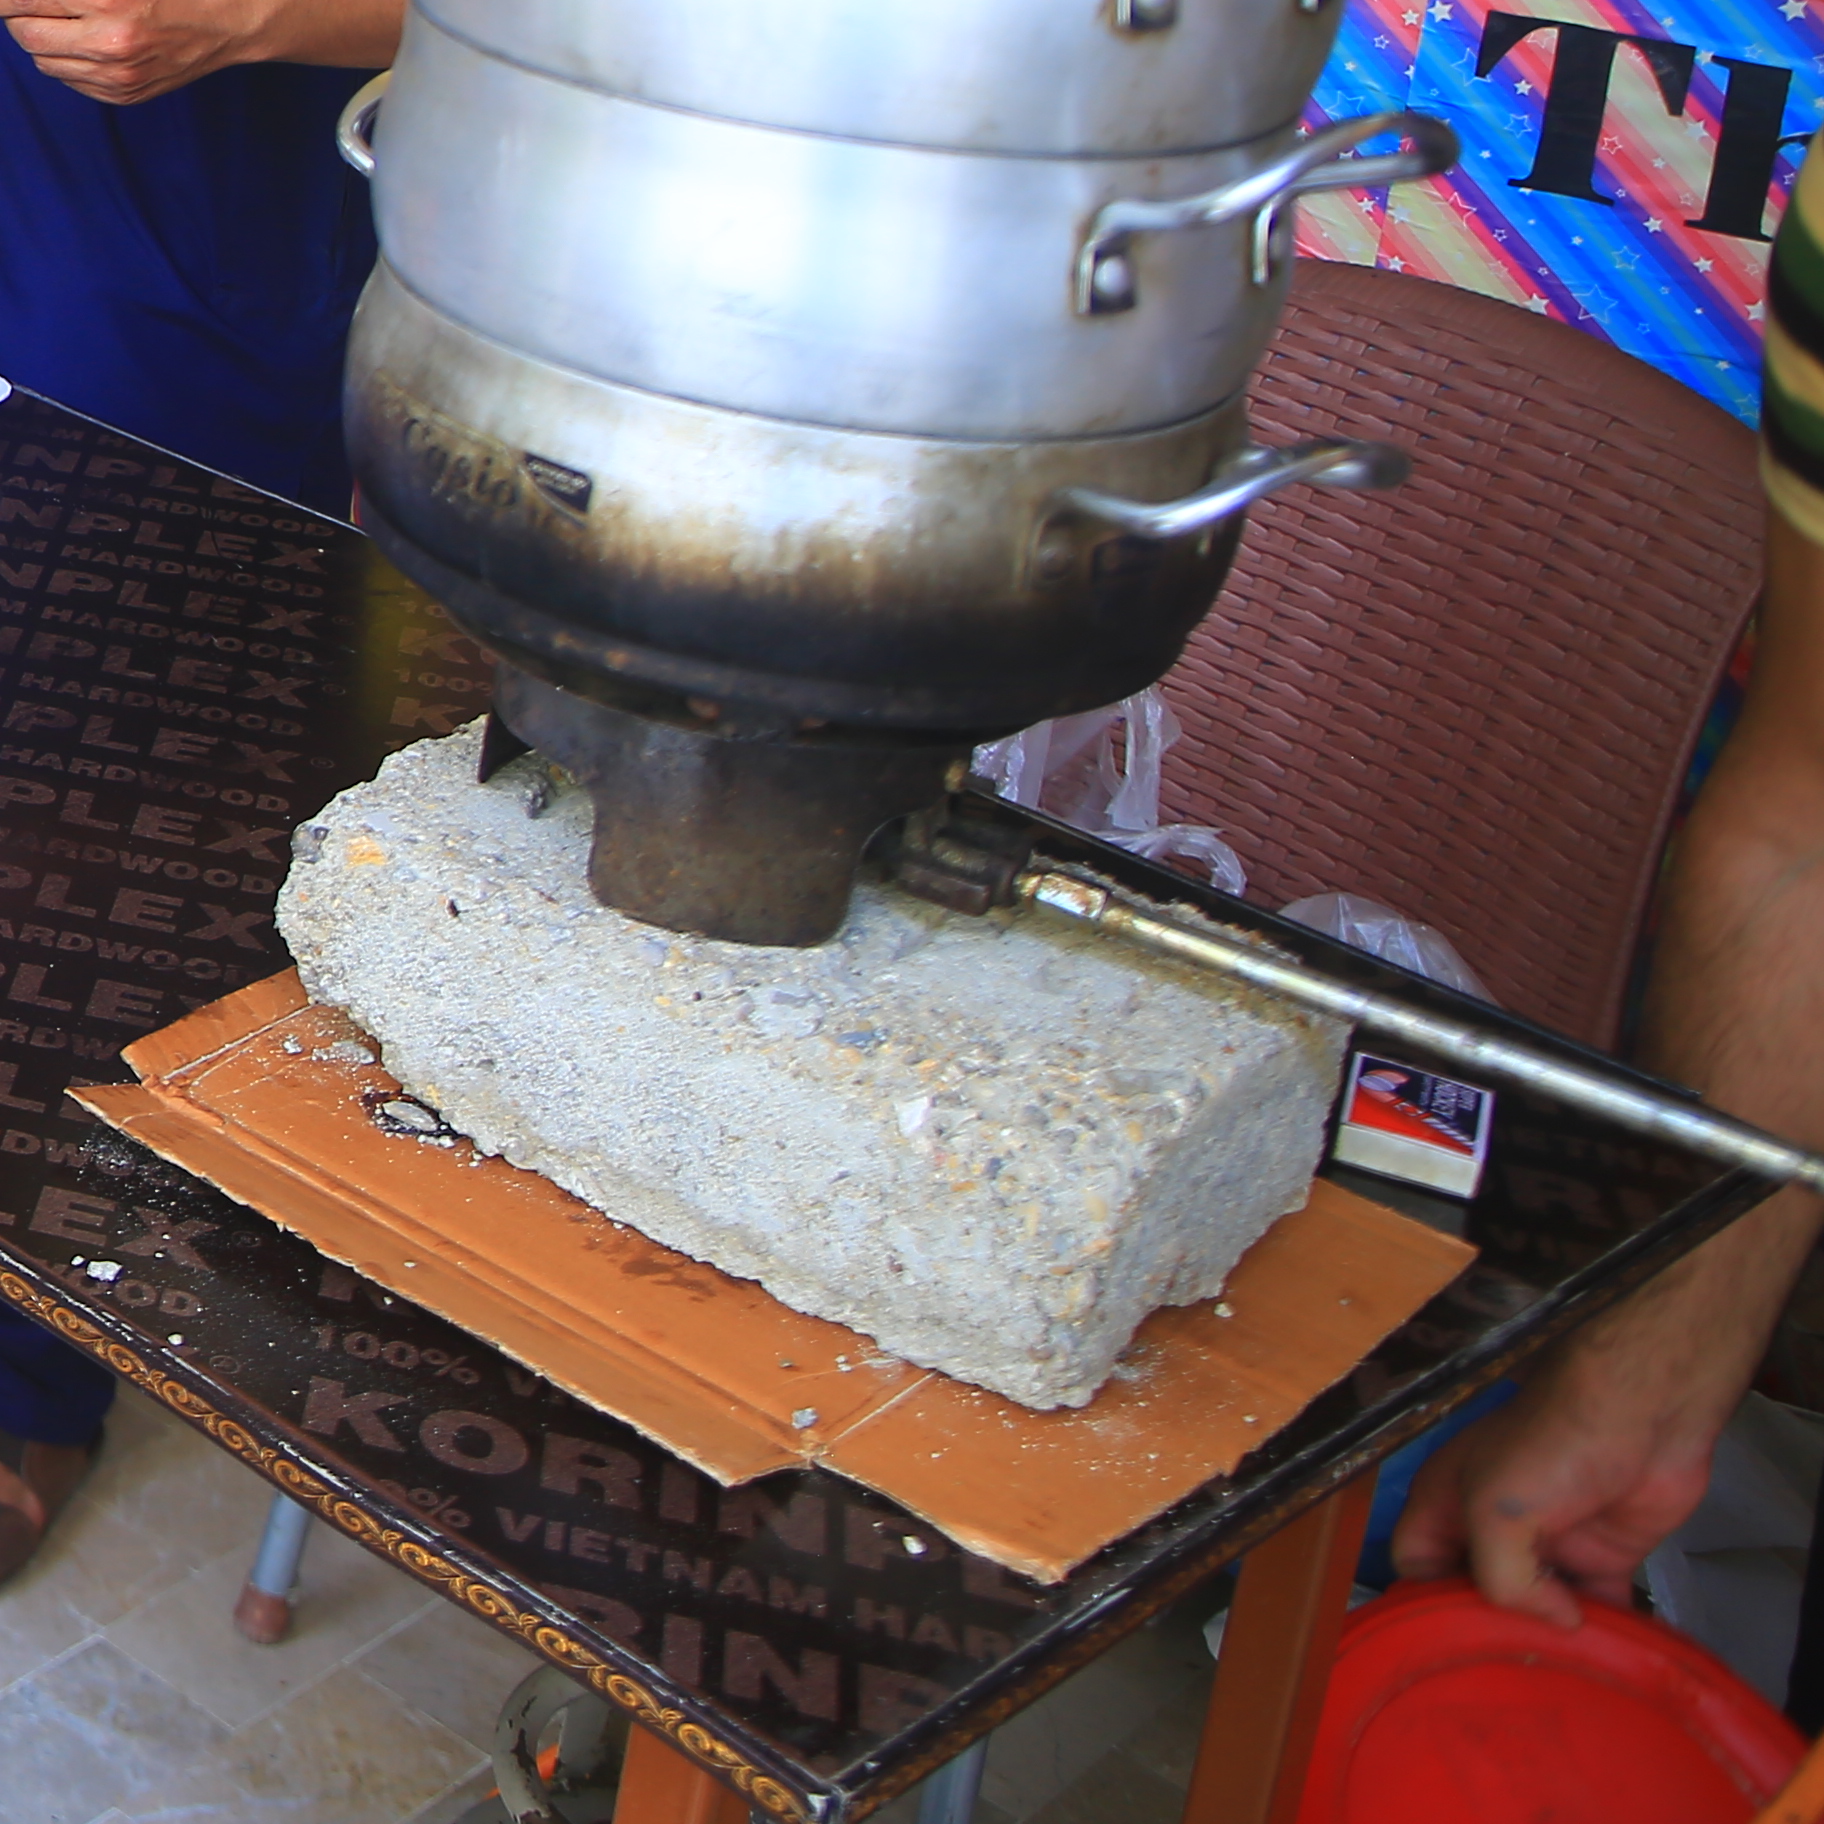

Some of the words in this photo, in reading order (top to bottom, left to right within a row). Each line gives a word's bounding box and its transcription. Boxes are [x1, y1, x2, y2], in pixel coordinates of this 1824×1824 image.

[60, 544, 325, 598] HARDWOOD
[40, 605, 315, 663] HARDWOOD
[19, 672, 304, 736] HARDWOOD
[315, 1323, 481, 1387] 100%
[495, 1505, 828, 1619] VIETNAM
